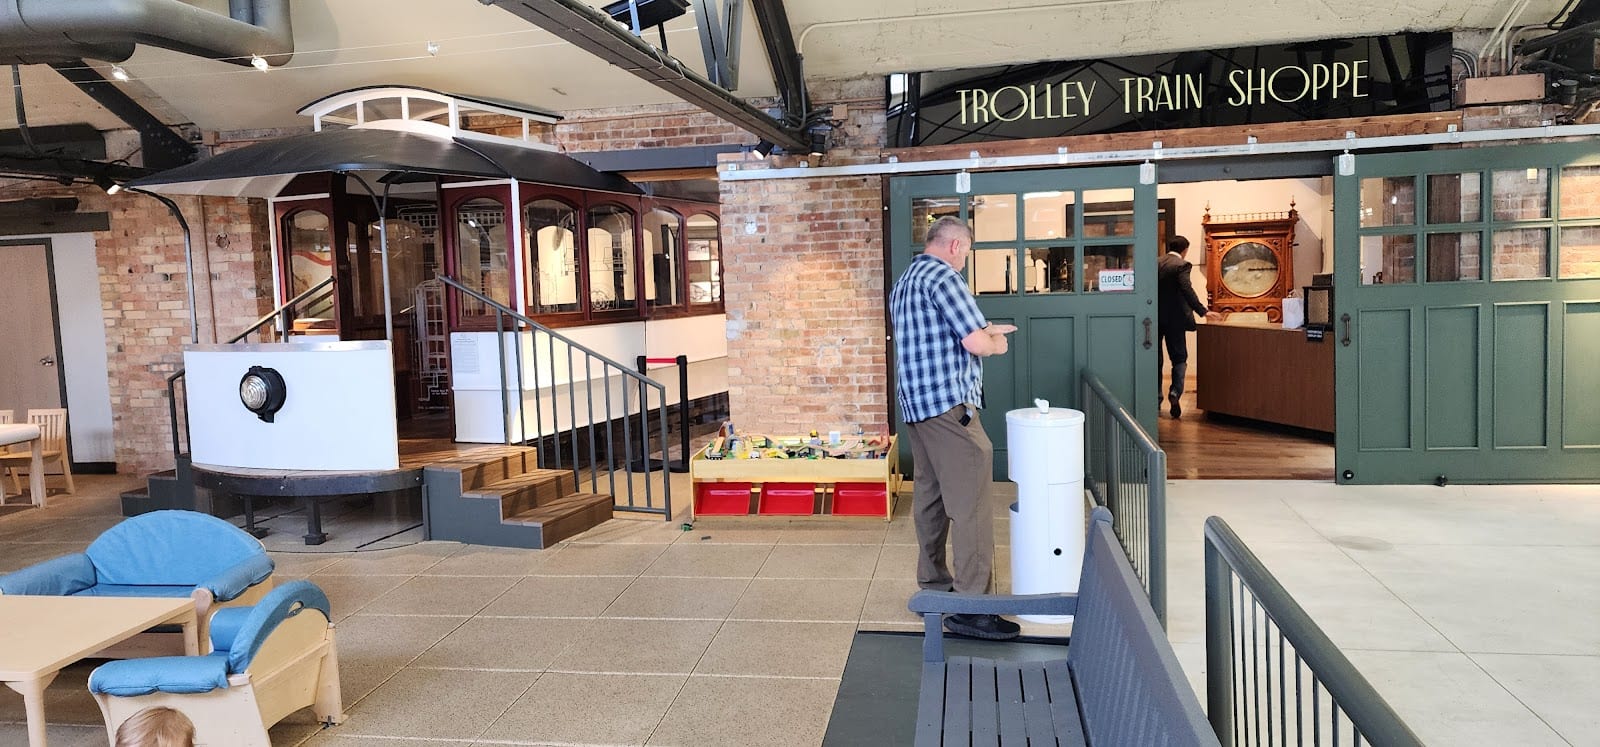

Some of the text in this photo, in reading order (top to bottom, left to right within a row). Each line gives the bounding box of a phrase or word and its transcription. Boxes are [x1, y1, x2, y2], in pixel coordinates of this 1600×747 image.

[956, 60, 1369, 125] TROLLEY TRAIN SHOPPE
[1100, 275, 1123, 283] CLOSED
